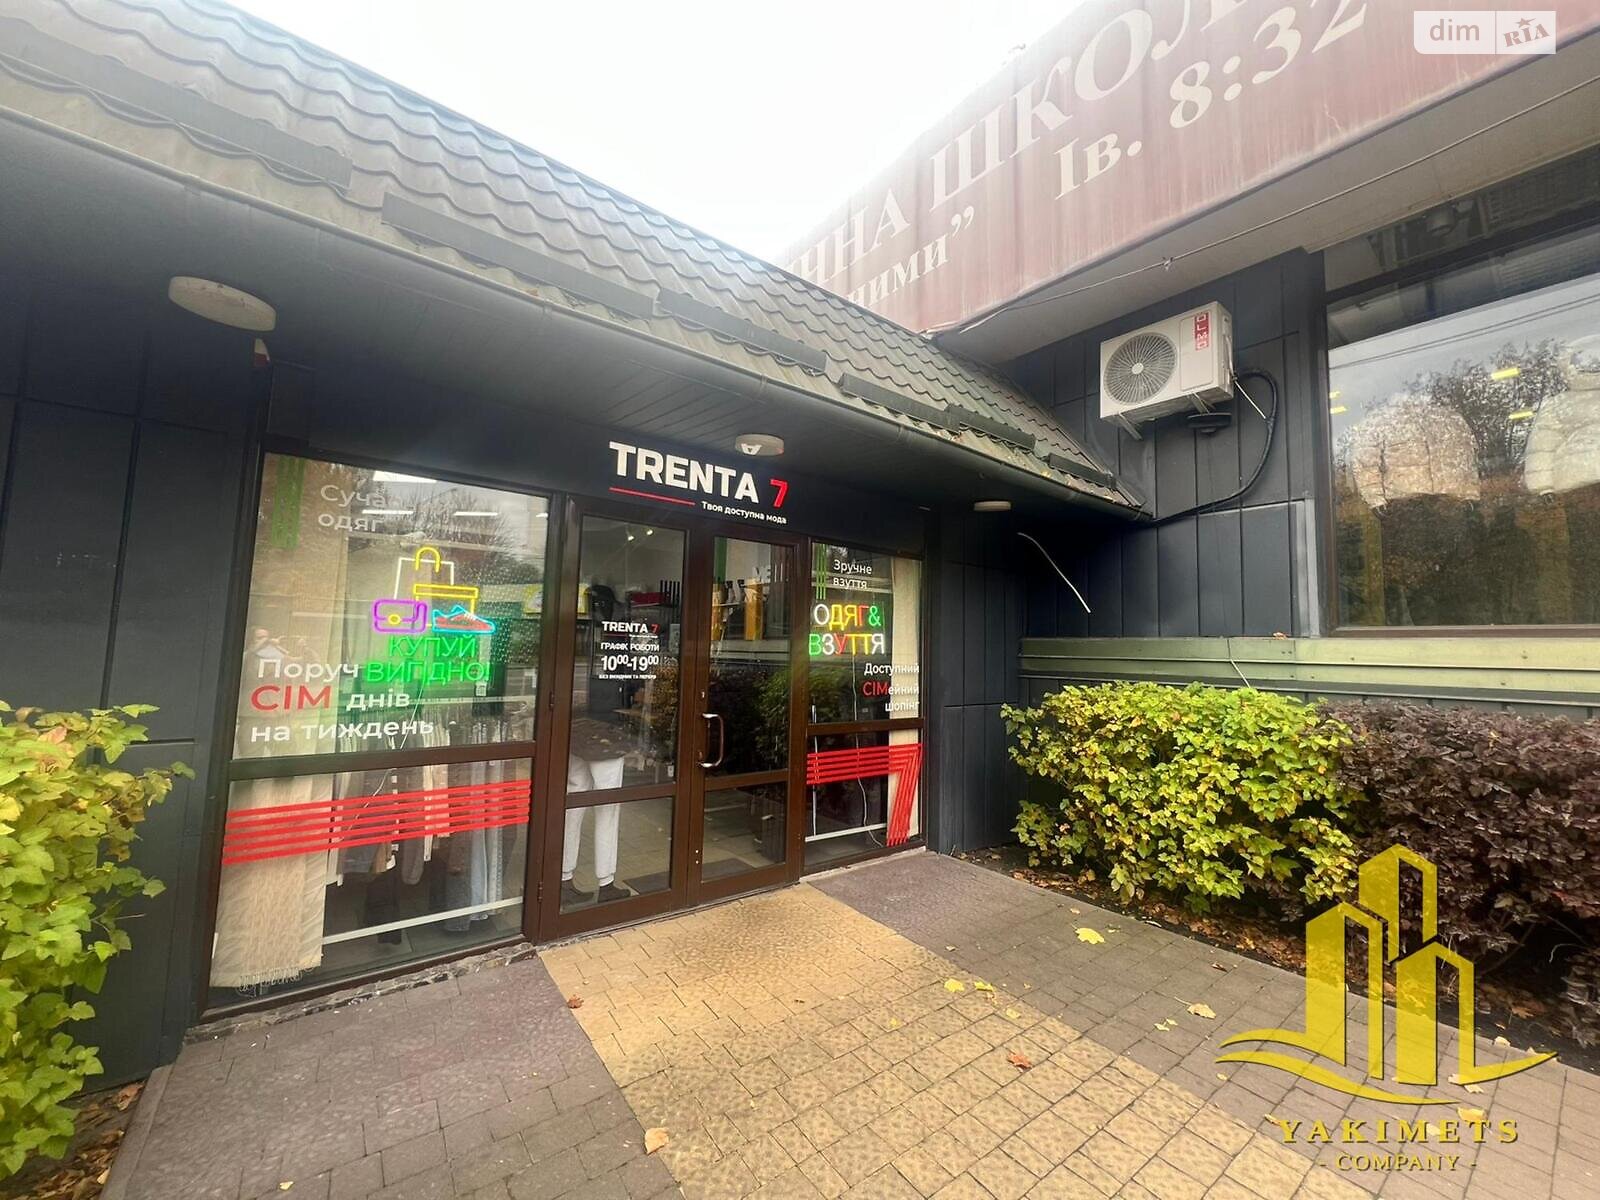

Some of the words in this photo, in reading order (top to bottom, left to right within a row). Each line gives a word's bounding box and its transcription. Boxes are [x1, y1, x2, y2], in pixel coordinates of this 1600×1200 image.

[1054, 133, 1143, 200] Ів.
[785, 187, 911, 289] ЧНА
[609, 441, 759, 504] TRENTA
[770, 478, 788, 508] 7
[318, 513, 384, 532] одяг
[701, 501, 723, 513] Твоя
[724, 506, 765, 520] доступна
[766, 509, 787, 524] мода
[833, 559, 872, 574] Зручне
[833, 577, 867, 590] взуття
[601, 621, 648, 633] TRENTA
[651, 624, 659, 634] 7
[389, 633, 478, 658] КУПУЙ
[630, 643, 660, 652] РОБОТИ
[808, 633, 885, 656] ВЗУТТЯ
[257, 658, 360, 683] Поруч
[365, 659, 491, 686] ВИГІДНО!
[864, 662, 920, 676] Доступний
[251, 685, 331, 711] СІМ
[345, 689, 410, 711] днів
[862, 681, 920, 696] СІМейний
[885, 701, 920, 713] шопінг
[251, 723, 290, 742] на
[297, 718, 434, 739] тиждень
